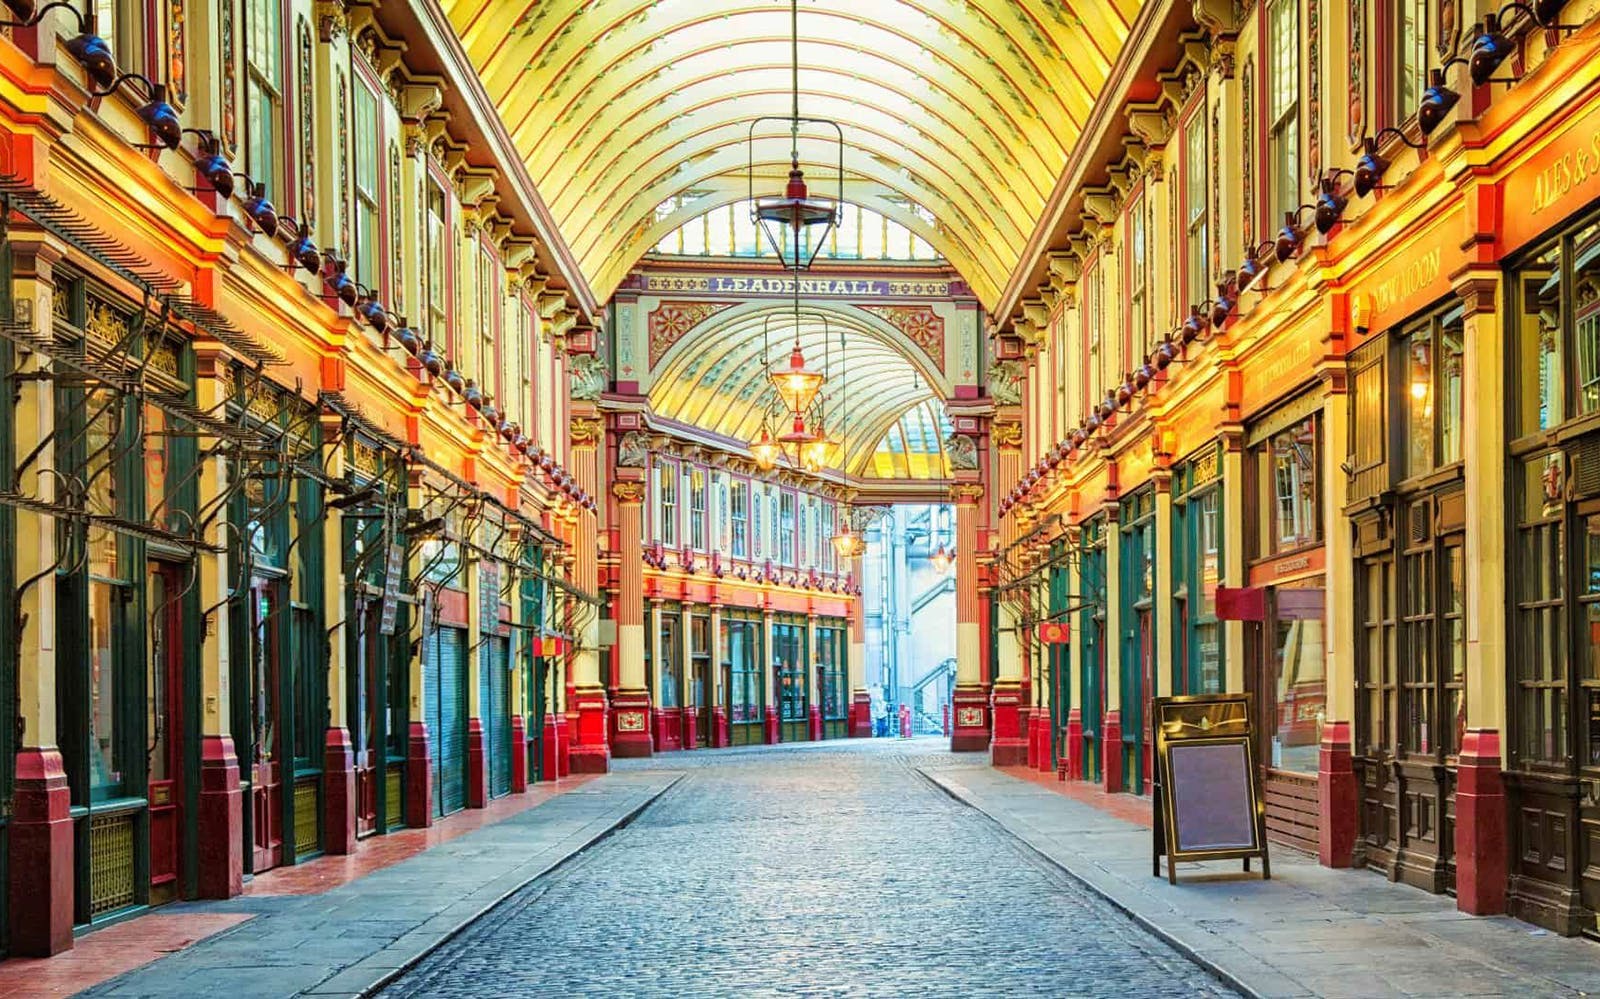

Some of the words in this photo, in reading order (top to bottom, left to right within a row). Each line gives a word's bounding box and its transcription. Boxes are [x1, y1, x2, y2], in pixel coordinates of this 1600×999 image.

[1531, 152, 1570, 214] ALES
[1574, 147, 1588, 186] &
[716, 278, 881, 295] LEADENHALL
[1398, 246, 1440, 302] MOON
